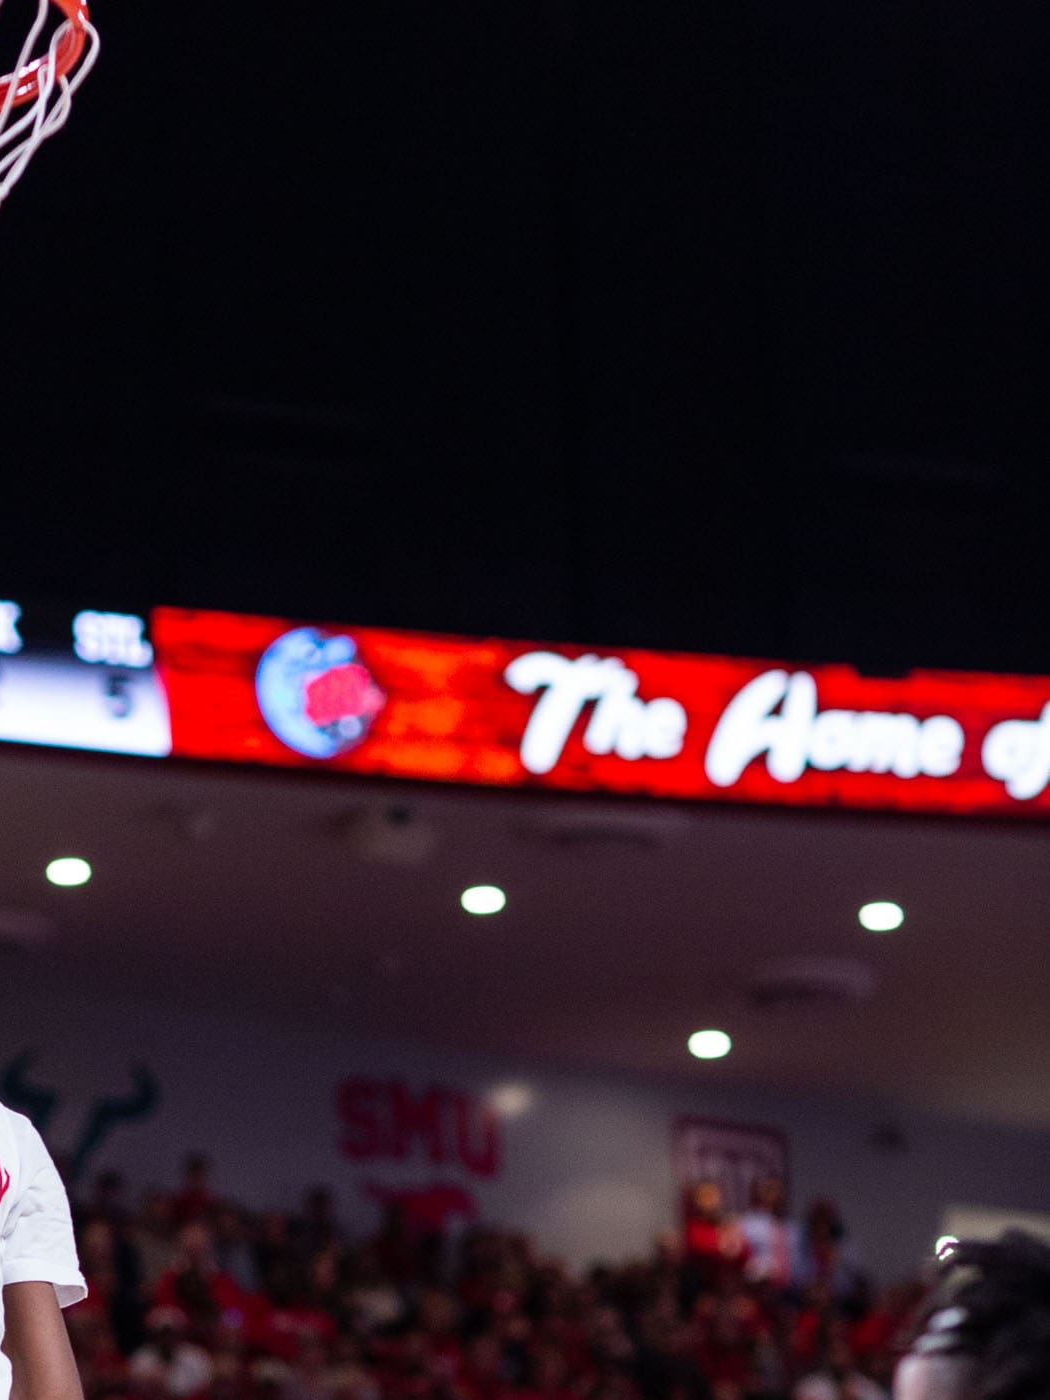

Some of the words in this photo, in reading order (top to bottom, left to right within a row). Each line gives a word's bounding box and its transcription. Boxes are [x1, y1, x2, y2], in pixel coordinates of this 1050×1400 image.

[504, 651, 688, 775] The
[705, 670, 965, 787] Home
[339, 1080, 501, 1179] SMU
